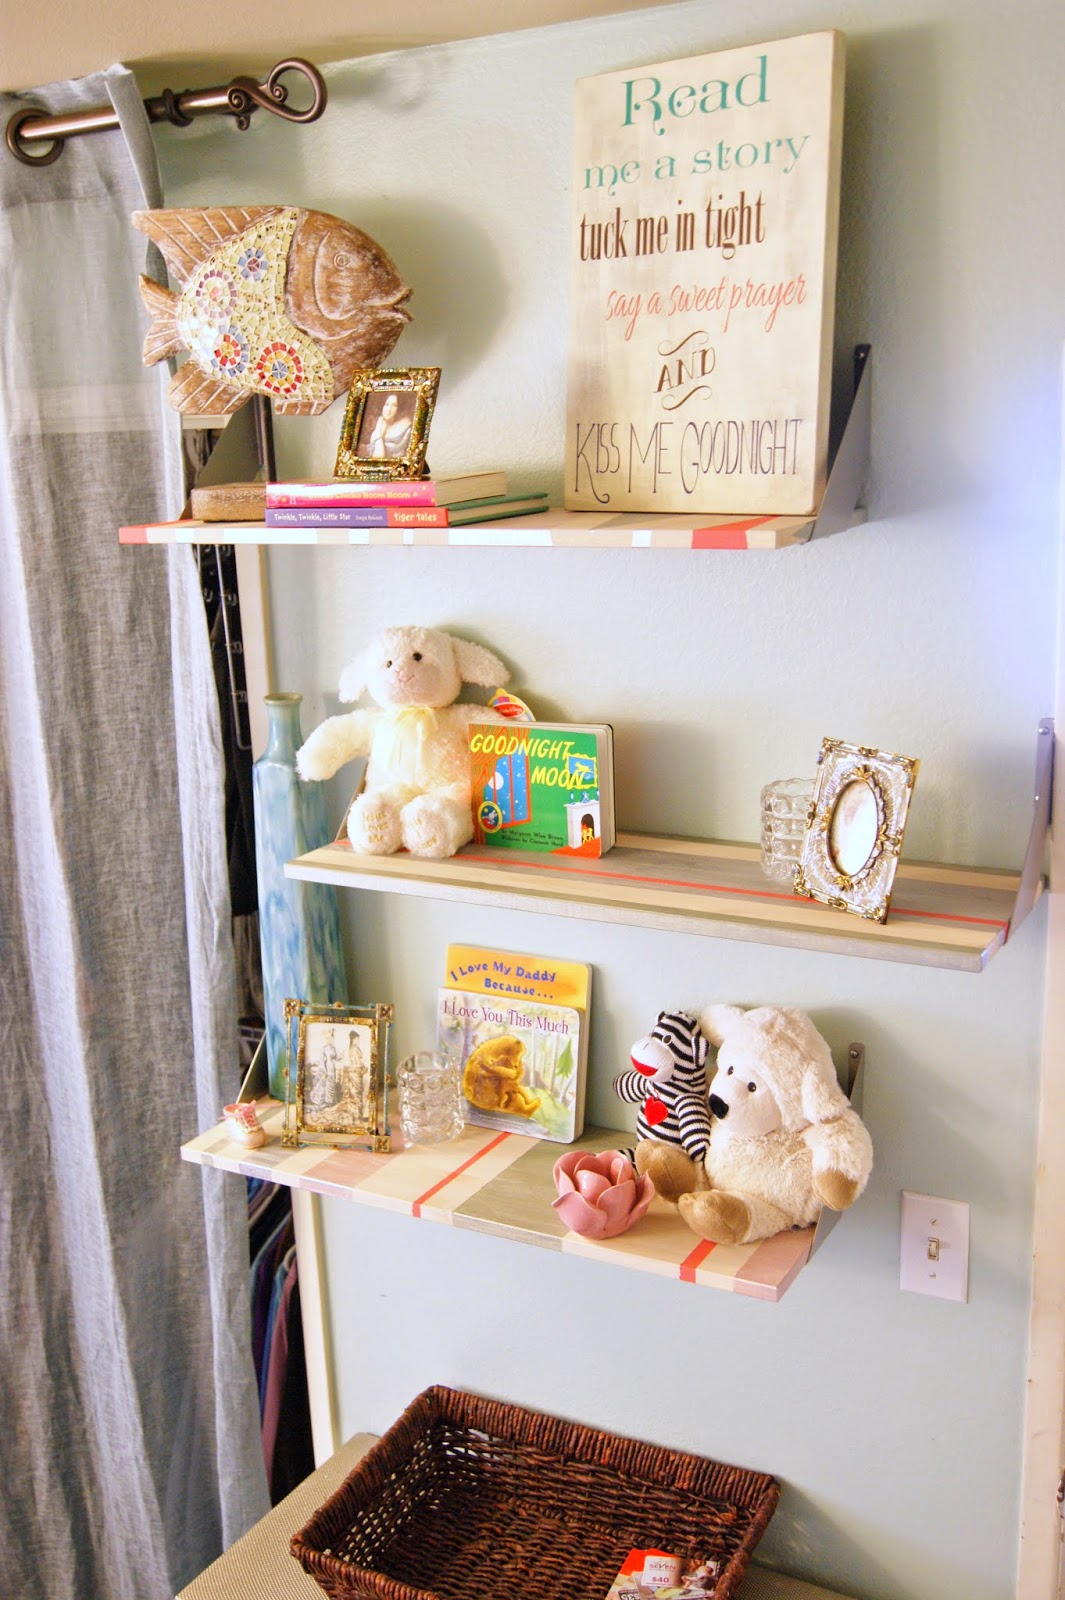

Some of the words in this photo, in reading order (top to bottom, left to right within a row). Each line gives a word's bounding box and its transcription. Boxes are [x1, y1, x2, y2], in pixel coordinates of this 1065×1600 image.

[620, 54, 771, 136] Read
[583, 159, 641, 197] me
[654, 155, 677, 180] a
[690, 135, 811, 174] story
[579, 207, 629, 261] tuck
[635, 213, 668, 256] me
[675, 199, 695, 252] in
[705, 189, 766, 260] tight
[605, 290, 641, 342] say
[646, 290, 662, 317] a
[668, 275, 726, 316] sweet
[724, 273, 807, 333] prayer
[653, 347, 716, 393] AND
[574, 422, 621, 504] KISS
[628, 421, 674, 493] ME
[680, 418, 803, 494] GOODNIGHT
[362, 491, 386, 499] Boom
[387, 491, 411, 499] Boom
[274, 513, 298, 522] Twinkle,
[299, 513, 322, 522] Twinkle,
[323, 513, 338, 521] Little
[340, 513, 351, 521] Star
[394, 512, 415, 523] tiger
[416, 512, 437, 522] tales
[470, 733, 575, 761] GOODNIGHT
[531, 765, 587, 789] MOON
[450, 970, 459, 982] I
[459, 961, 488, 976] Love
[493, 961, 512, 976] My
[515, 966, 556, 983] Daddy
[484, 978, 554, 1000] Because...
[443, 1000, 449, 1014] I
[451, 1001, 478, 1019] Love
[481, 1006, 503, 1023] You
[506, 1008, 532, 1028] This
[535, 1016, 569, 1036] Much
